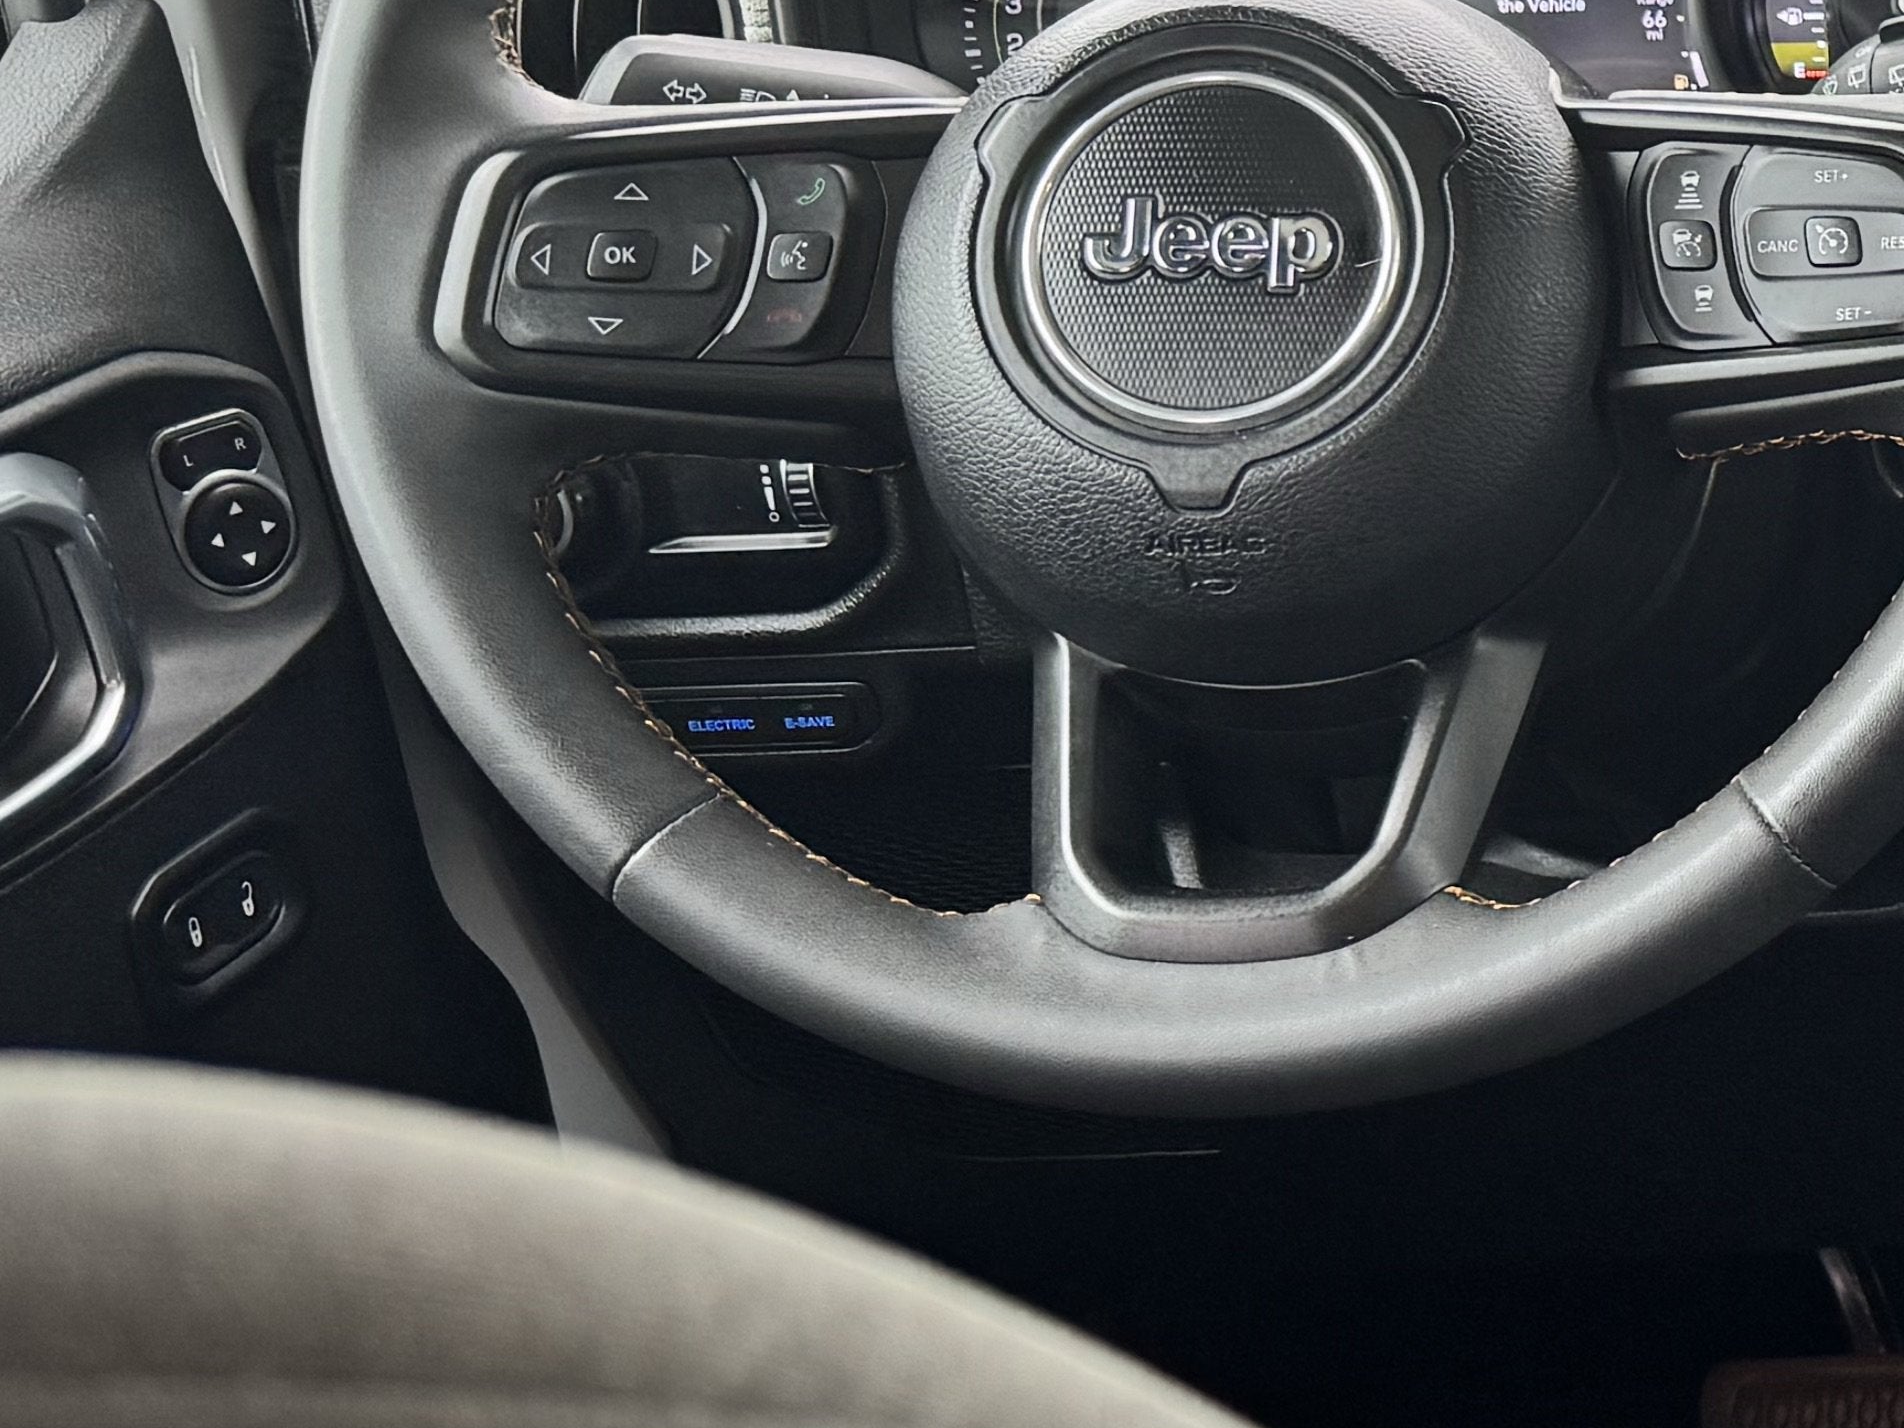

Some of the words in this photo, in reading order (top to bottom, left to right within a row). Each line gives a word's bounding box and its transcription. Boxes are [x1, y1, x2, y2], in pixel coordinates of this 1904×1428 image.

[1642, 9, 1668, 28] 66
[1006, 32, 1024, 52] 2
[1645, 28, 1664, 41] mi
[1083, 194, 1344, 295] Jeep
[1757, 239, 1799, 254] CANC
[604, 245, 637, 266] OK
[234, 437, 247, 452] R
[182, 453, 194, 467] L
[688, 718, 756, 732] ELECTRIC
[785, 714, 836, 730] E-SAVE
